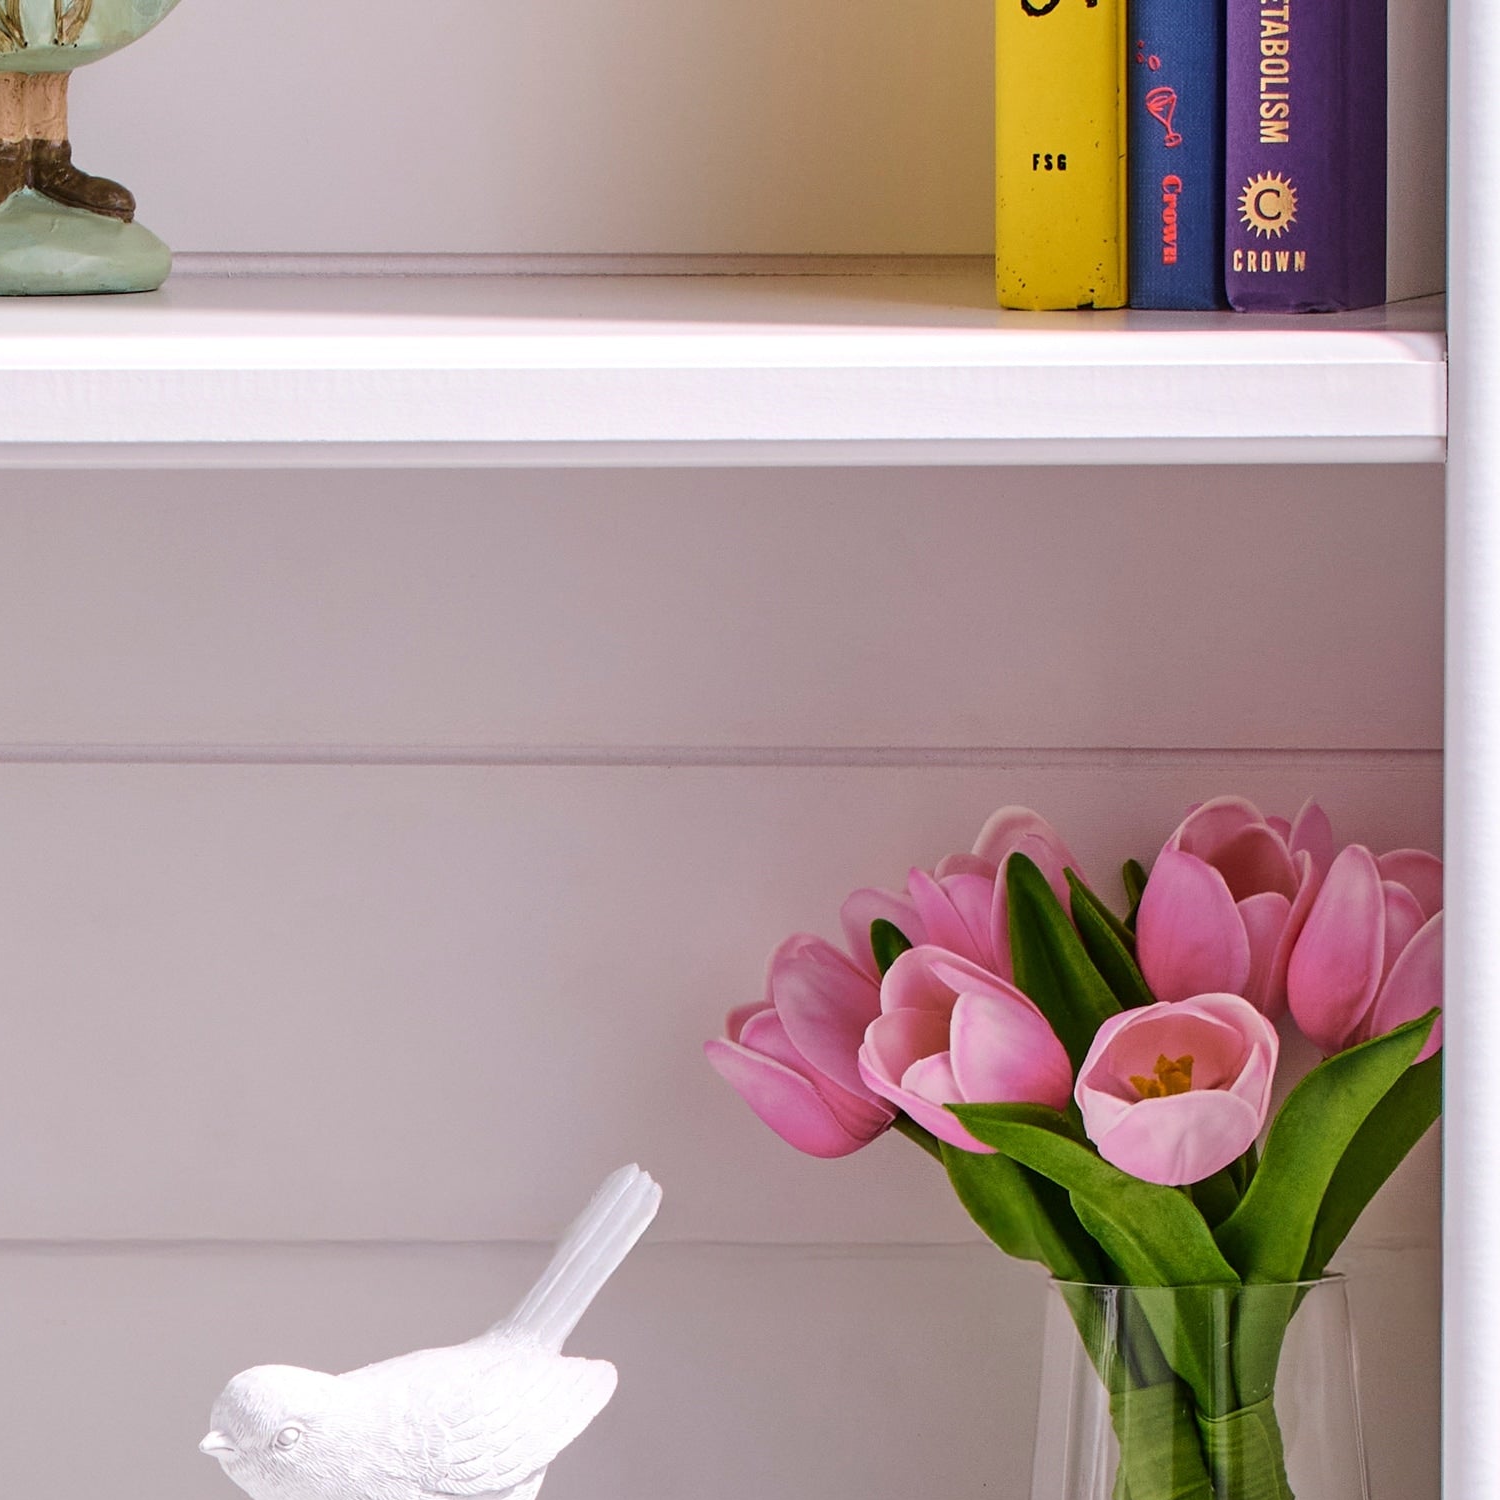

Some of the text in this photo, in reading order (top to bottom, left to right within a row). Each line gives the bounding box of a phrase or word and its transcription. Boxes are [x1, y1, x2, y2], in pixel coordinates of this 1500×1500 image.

[1032, 153, 1067, 171] FSG
[1162, 174, 1182, 265] Crown
[1233, 250, 1307, 272] CROWN
